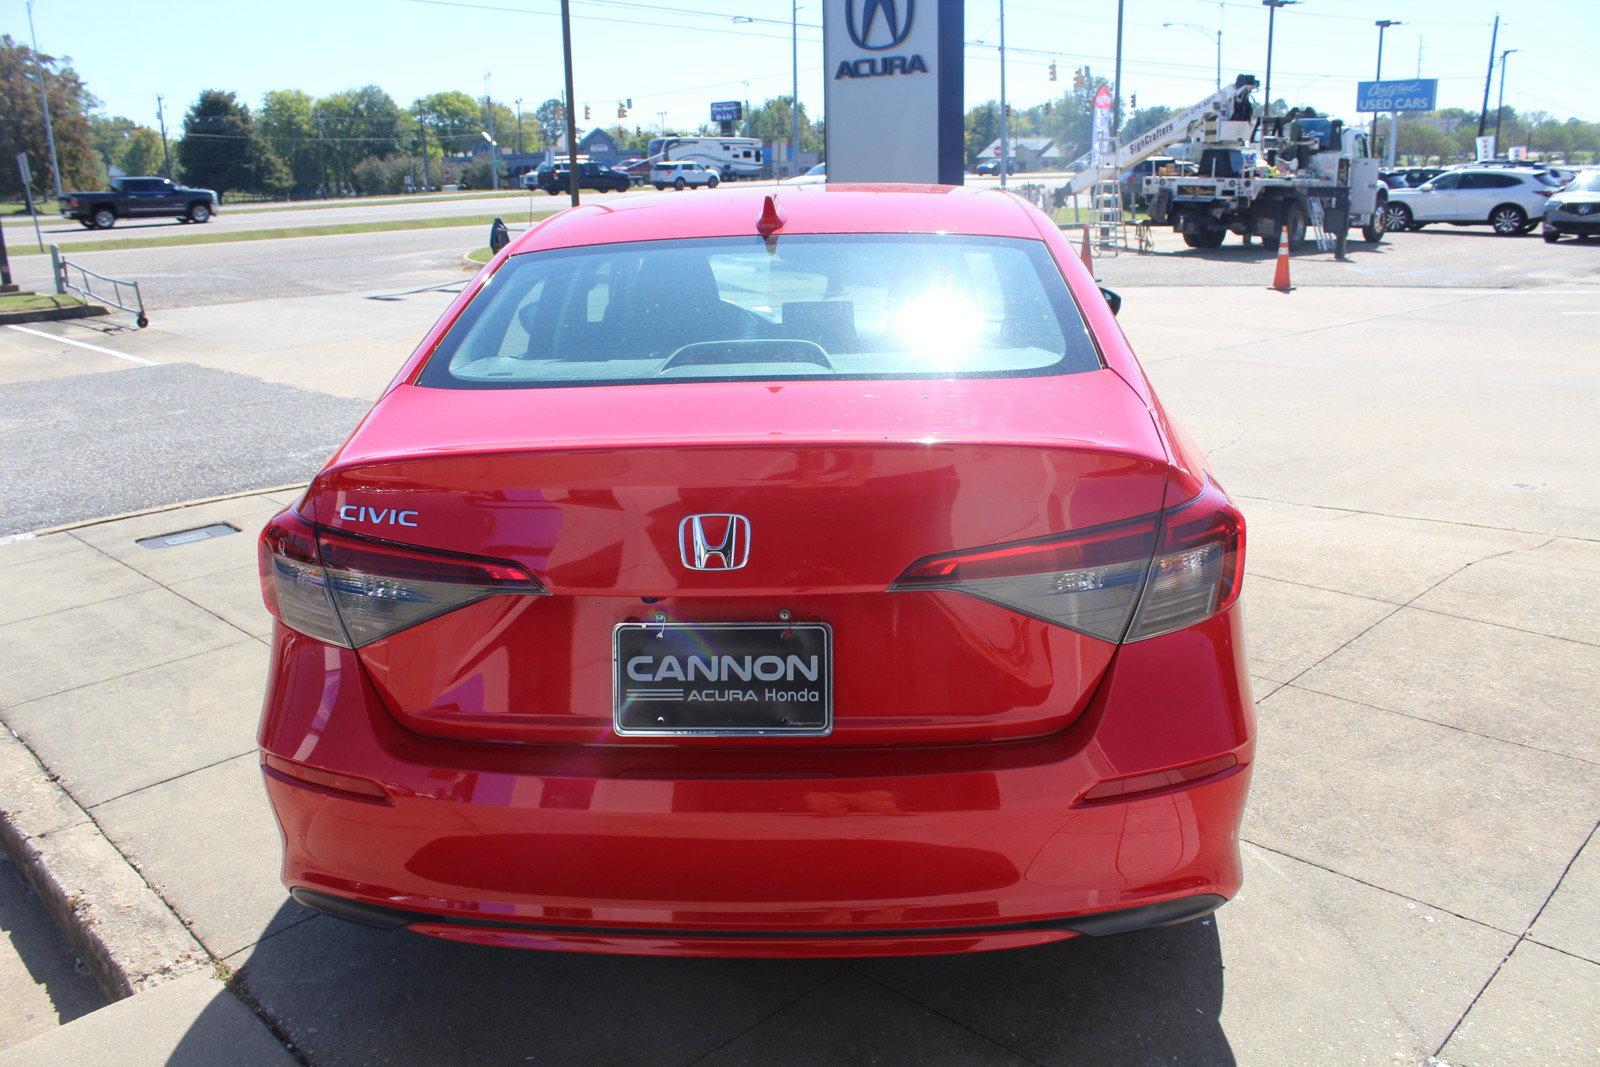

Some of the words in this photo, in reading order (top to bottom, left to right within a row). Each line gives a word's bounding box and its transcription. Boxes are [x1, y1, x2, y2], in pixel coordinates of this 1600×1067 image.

[834, 54, 928, 80] ACURA
[1367, 82, 1422, 97] Certified
[1360, 99, 1392, 110] USED
[1395, 98, 1428, 109] CARS
[1129, 123, 1174, 154] SignCrafters
[340, 504, 419, 527] CIVIC
[626, 655, 818, 682] CANNON
[687, 689, 759, 702] ACURA
[764, 688, 819, 702] Honda
